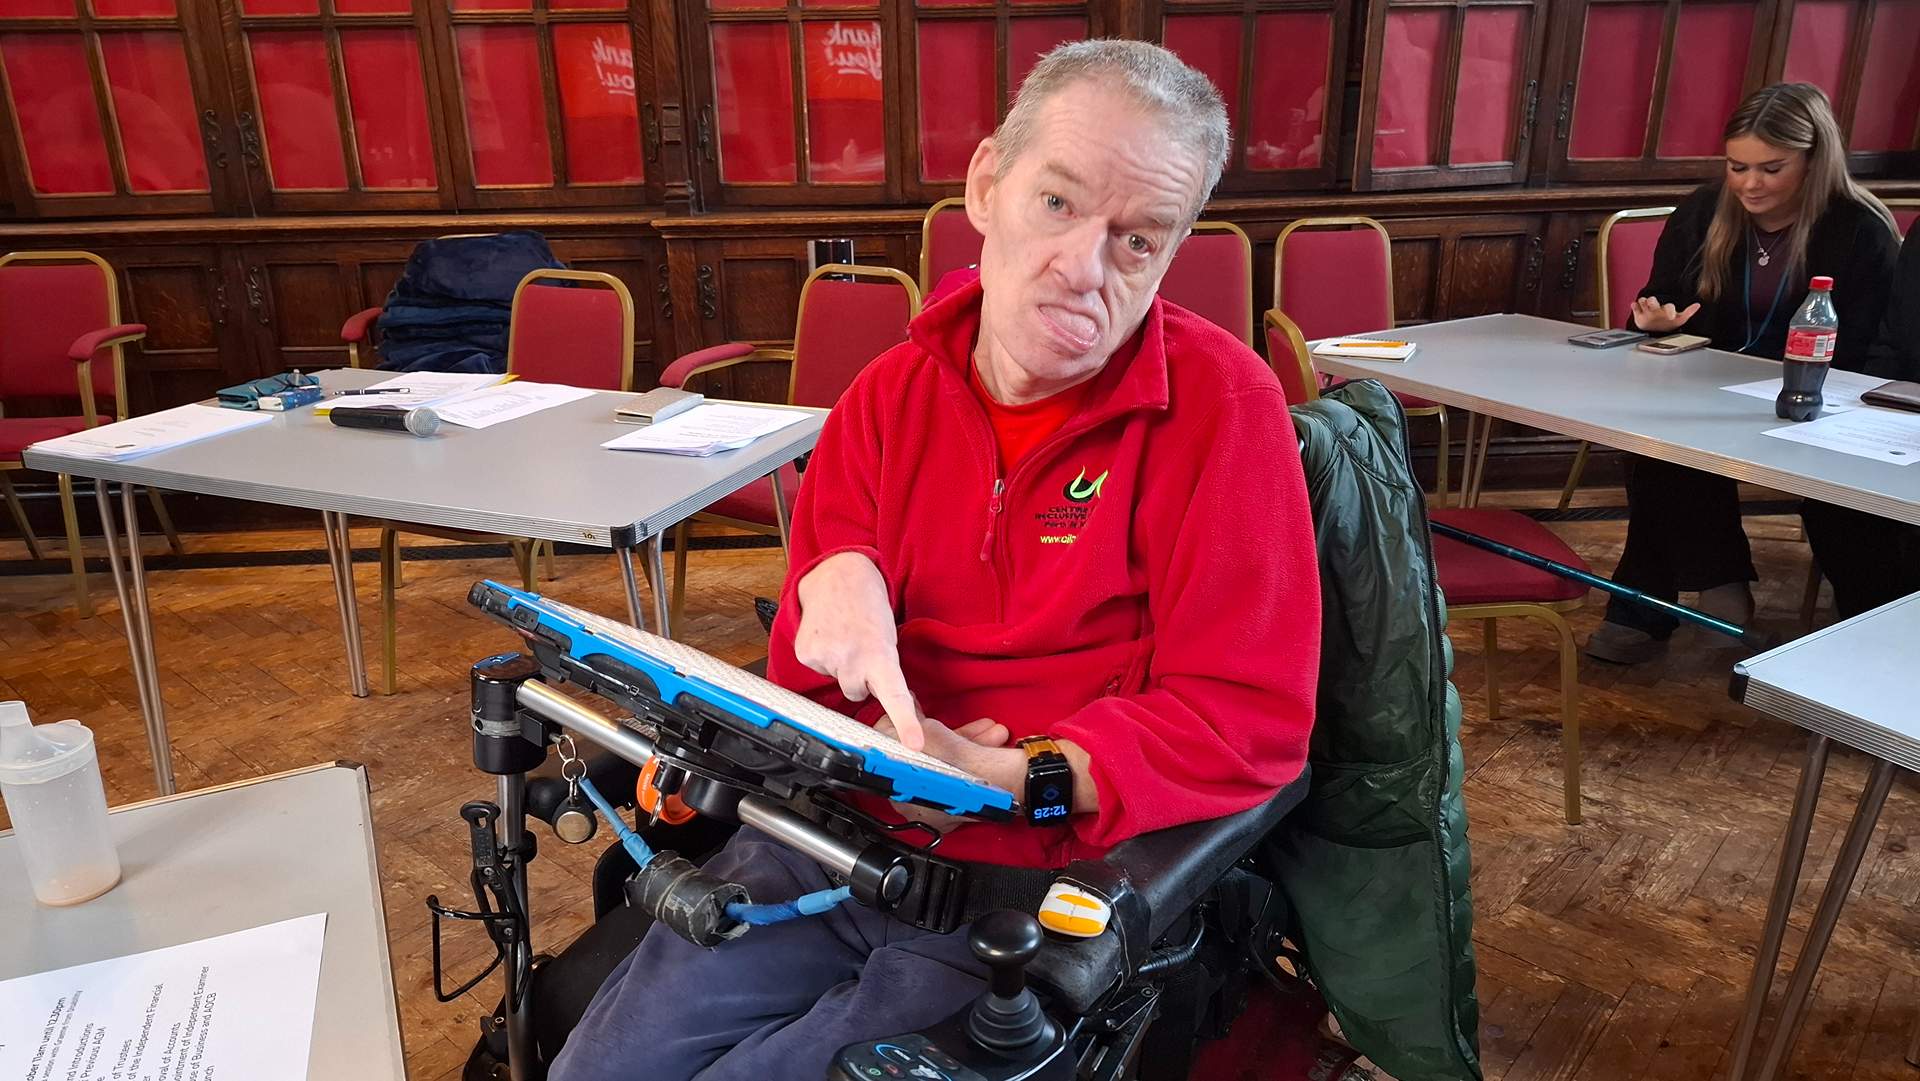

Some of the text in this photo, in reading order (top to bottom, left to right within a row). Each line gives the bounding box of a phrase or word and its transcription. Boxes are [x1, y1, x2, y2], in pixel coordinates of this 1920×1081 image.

[1034, 805, 1067, 819] 12:25
[182, 995, 202, 1039] Independent
[193, 966, 209, 996] Examiner
[132, 1013, 155, 1058] Independent
[146, 983, 164, 1013] Financial
[67, 1022, 94, 1070] Introductions
[113, 1039, 132, 1071] Trustees
[164, 1022, 181, 1055] Accounts
[191, 1028, 209, 1061] Business
[80, 1046, 100, 1079] Previous
